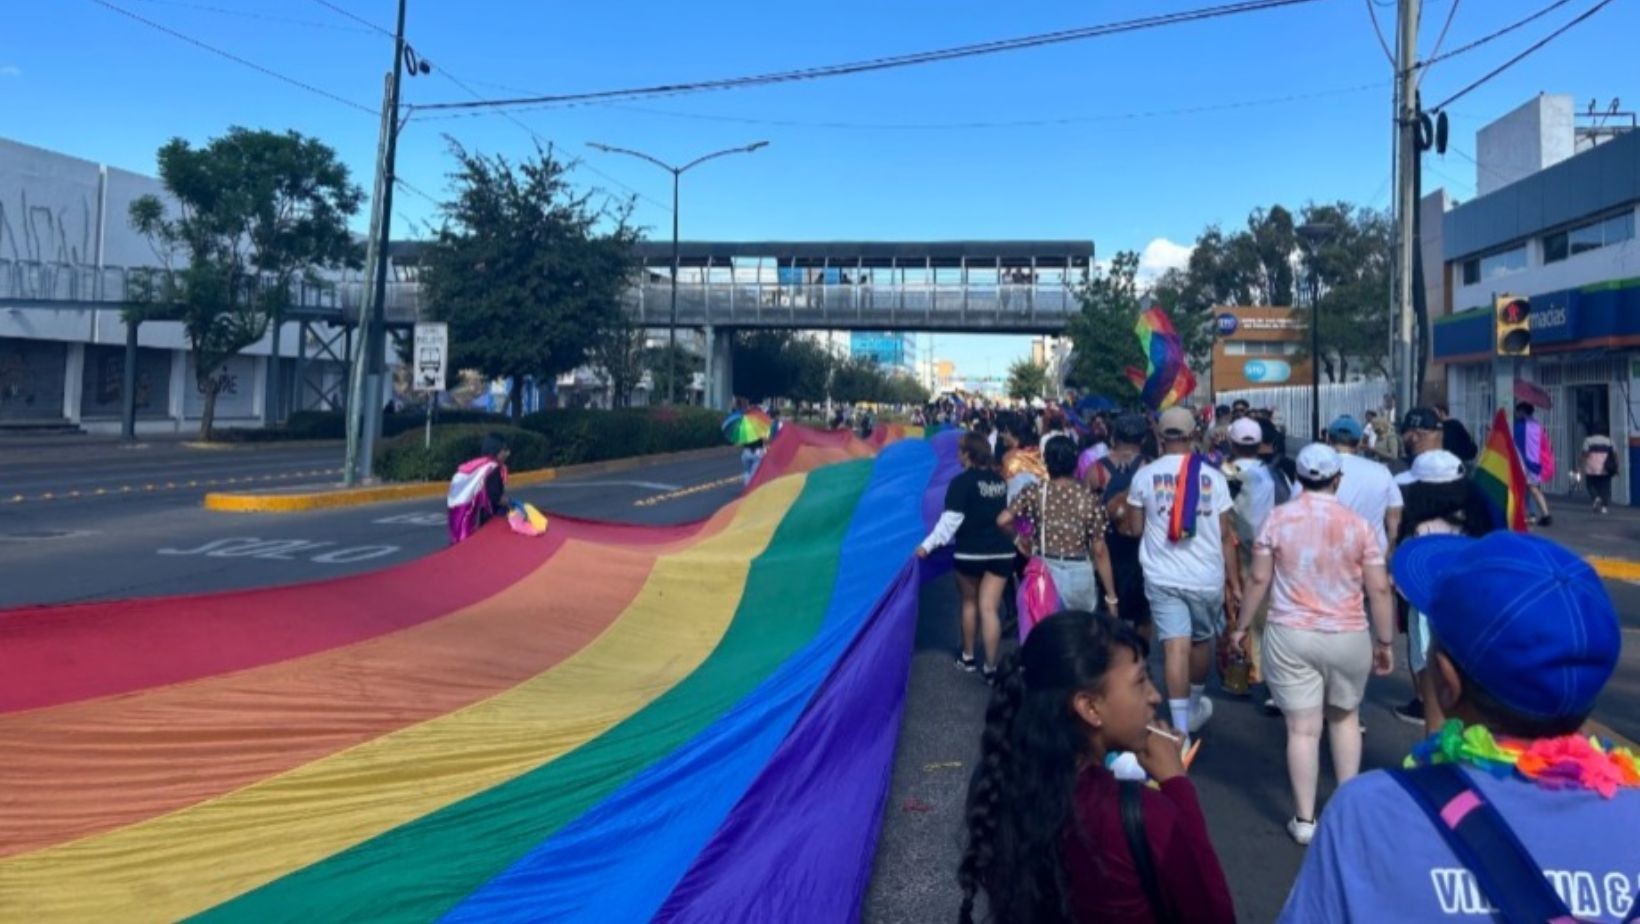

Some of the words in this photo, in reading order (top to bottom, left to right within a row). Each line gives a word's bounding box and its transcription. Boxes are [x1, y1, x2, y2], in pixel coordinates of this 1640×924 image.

[1530, 303, 1566, 328] macias
[156, 537, 401, 563] SOLO
[1603, 872, 1634, 918] &
